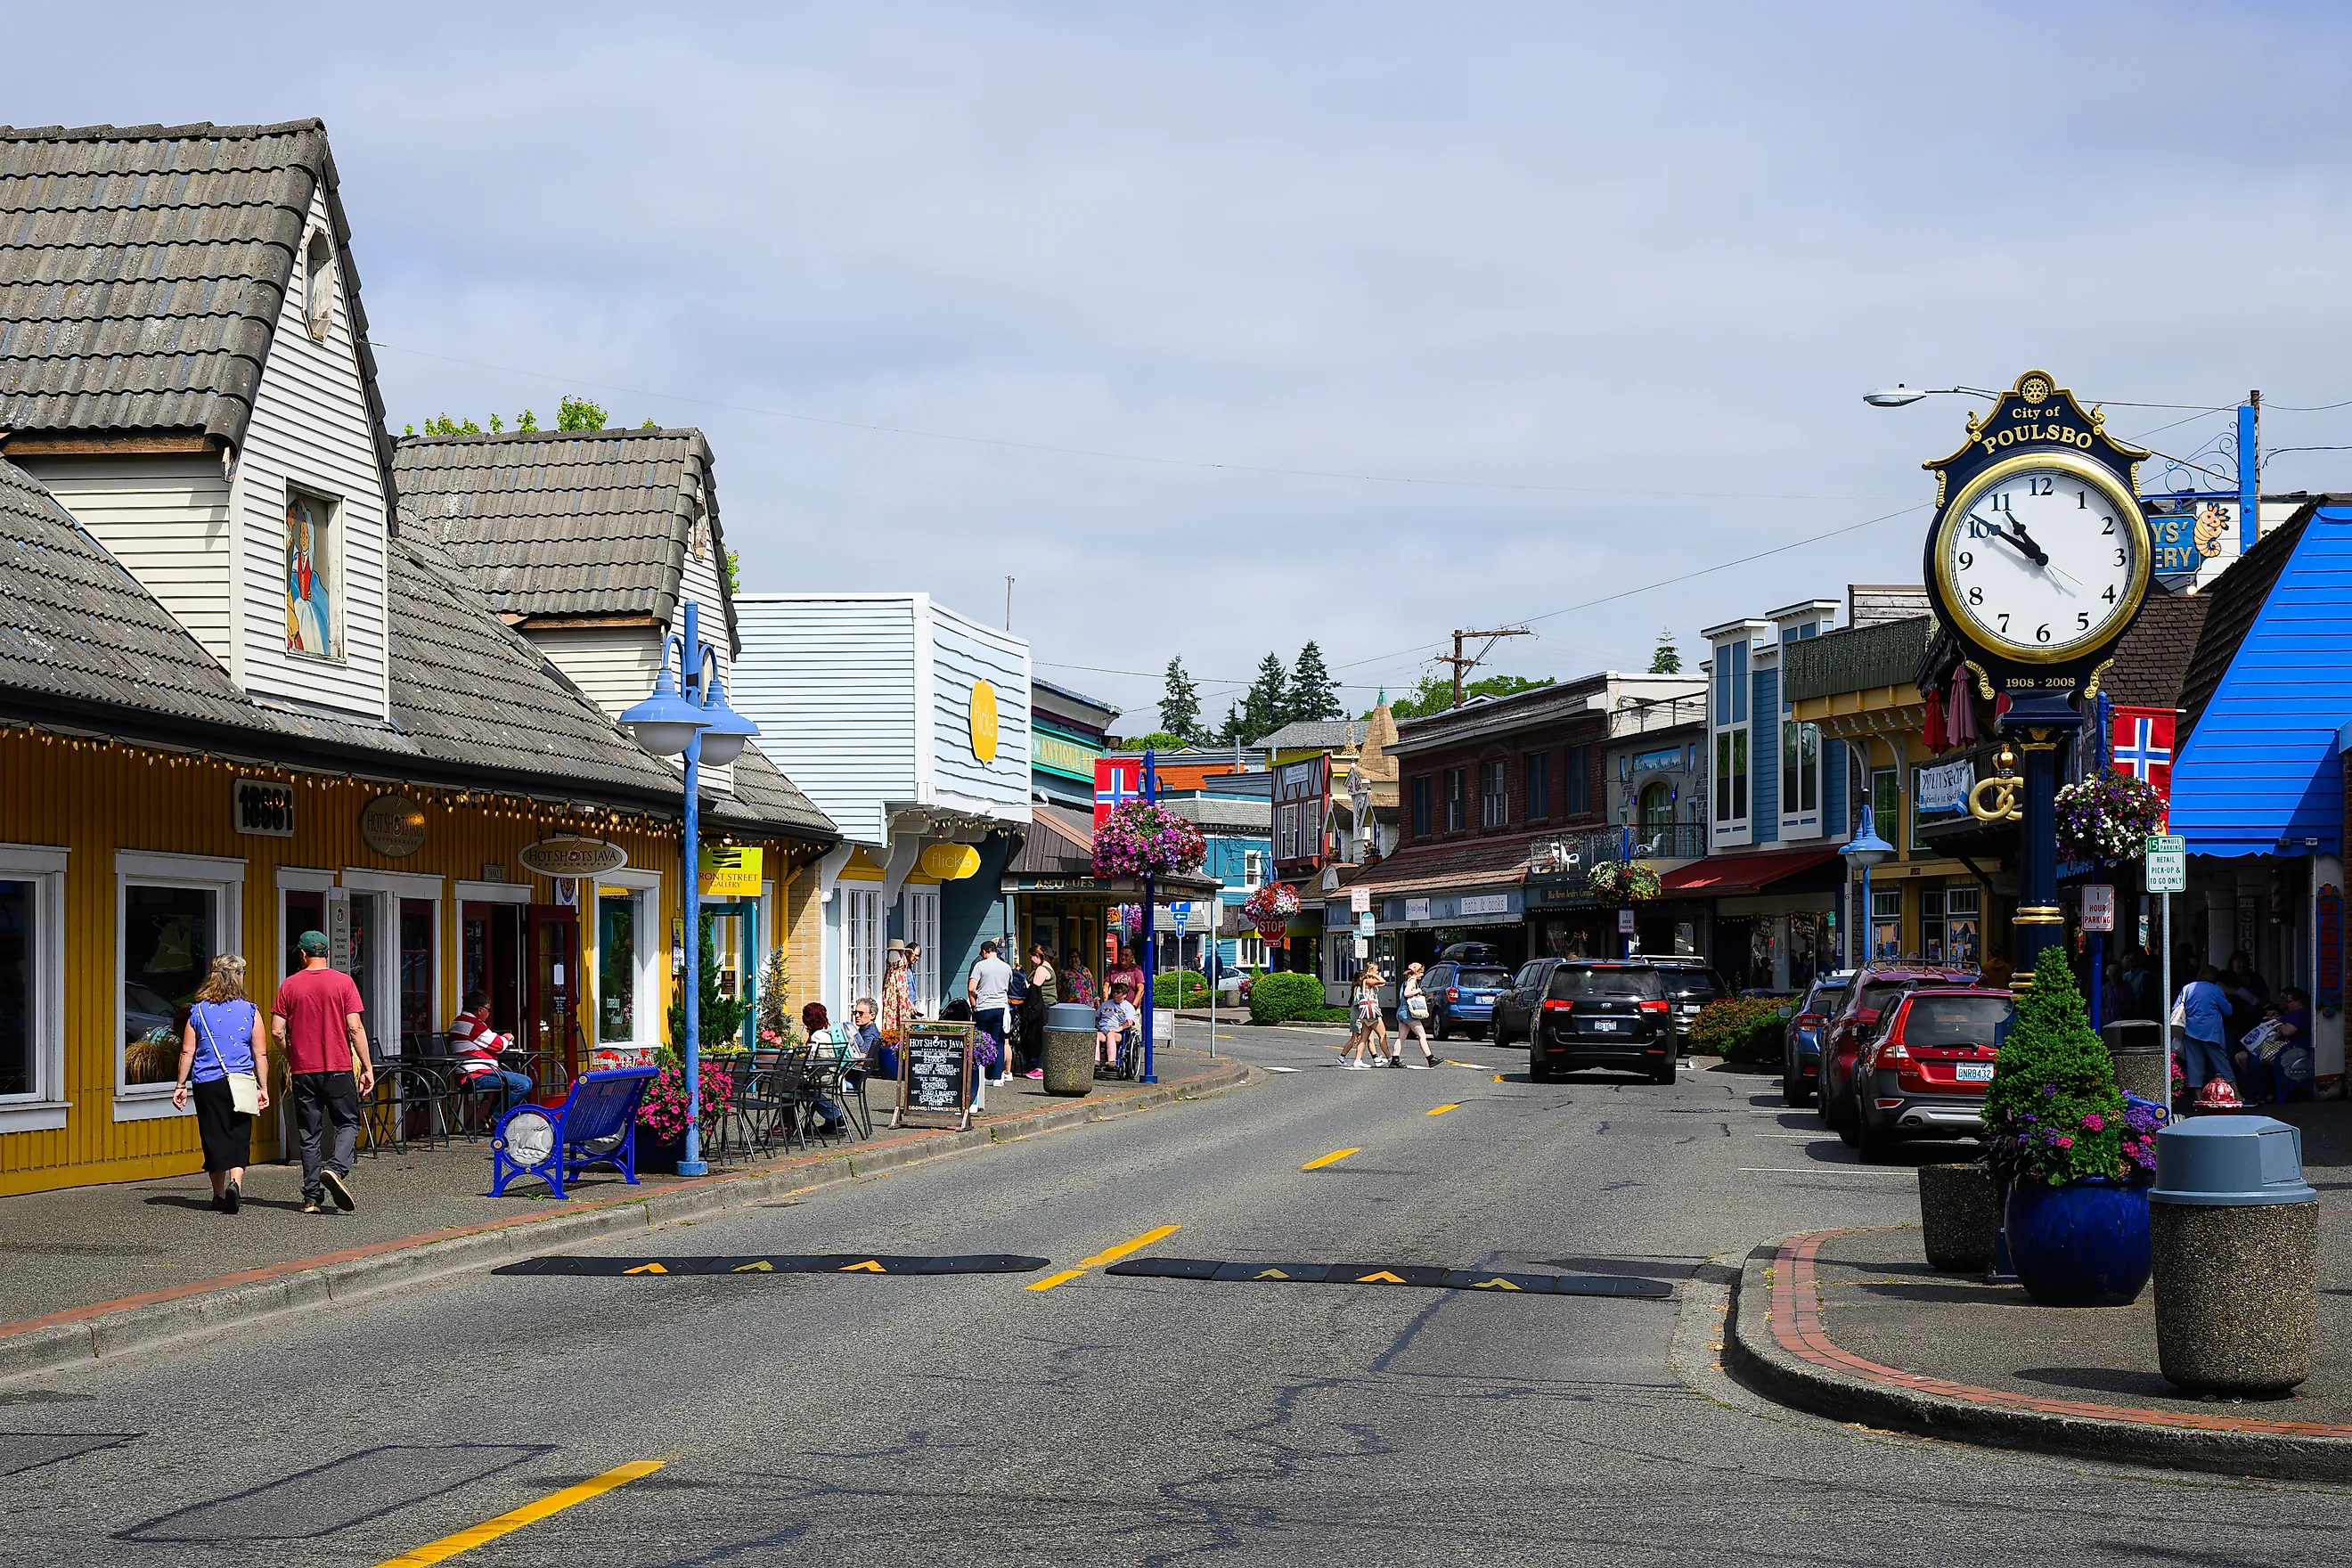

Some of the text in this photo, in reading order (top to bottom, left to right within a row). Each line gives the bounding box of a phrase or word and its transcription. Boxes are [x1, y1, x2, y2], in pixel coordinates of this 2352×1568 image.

[2012, 406, 2061, 420] City of
[1981, 424, 2093, 454] POULSBO
[2029, 477, 2054, 496] 12
[1990, 492, 2013, 512] 11
[2077, 490, 2088, 510] 1
[1967, 519, 1991, 539] 10
[2101, 516, 2115, 535] 2
[1958, 551, 1973, 571] 9
[2112, 547, 2127, 568] 3
[2155, 546, 2193, 568] ERY
[1969, 586, 1984, 606] 8
[2101, 584, 2117, 605] 4
[1997, 613, 2010, 633] 7
[2076, 611, 2089, 631] 5
[2036, 623, 2051, 643] 6
[2005, 678, 2035, 688] 1908
[2045, 677, 2076, 687] 2008
[974, 701, 994, 738] flicka
[1041, 739, 1081, 770] ANTIQUE
[1082, 750, 1101, 773] MA
[367, 811, 384, 833] HOT
[2148, 839, 2159, 851] 15
[528, 850, 553, 862] HOT
[593, 850, 617, 865] JAVA
[931, 853, 972, 869] flicka
[698, 872, 758, 882] RONT STREET
[2151, 866, 2181, 874] PICK-UP &
[1034, 878, 1095, 889] ANTIQUES
[2150, 877, 2183, 885] TO GO ONLY
[1082, 895, 1112, 903] MEOW
[1464, 899, 1477, 912] bath
[1488, 896, 1504, 911] books
[2095, 892, 2100, 901] 1
[2089, 904, 2107, 912] HOUR
[1259, 920, 1285, 933] STOP
[2084, 916, 2111, 924] PARKING
[2320, 900, 2340, 989] BARBER
[910, 1039, 923, 1048] HOT
[949, 1039, 964, 1049] JAVA
[1957, 1068, 1992, 1079] BNR8432
